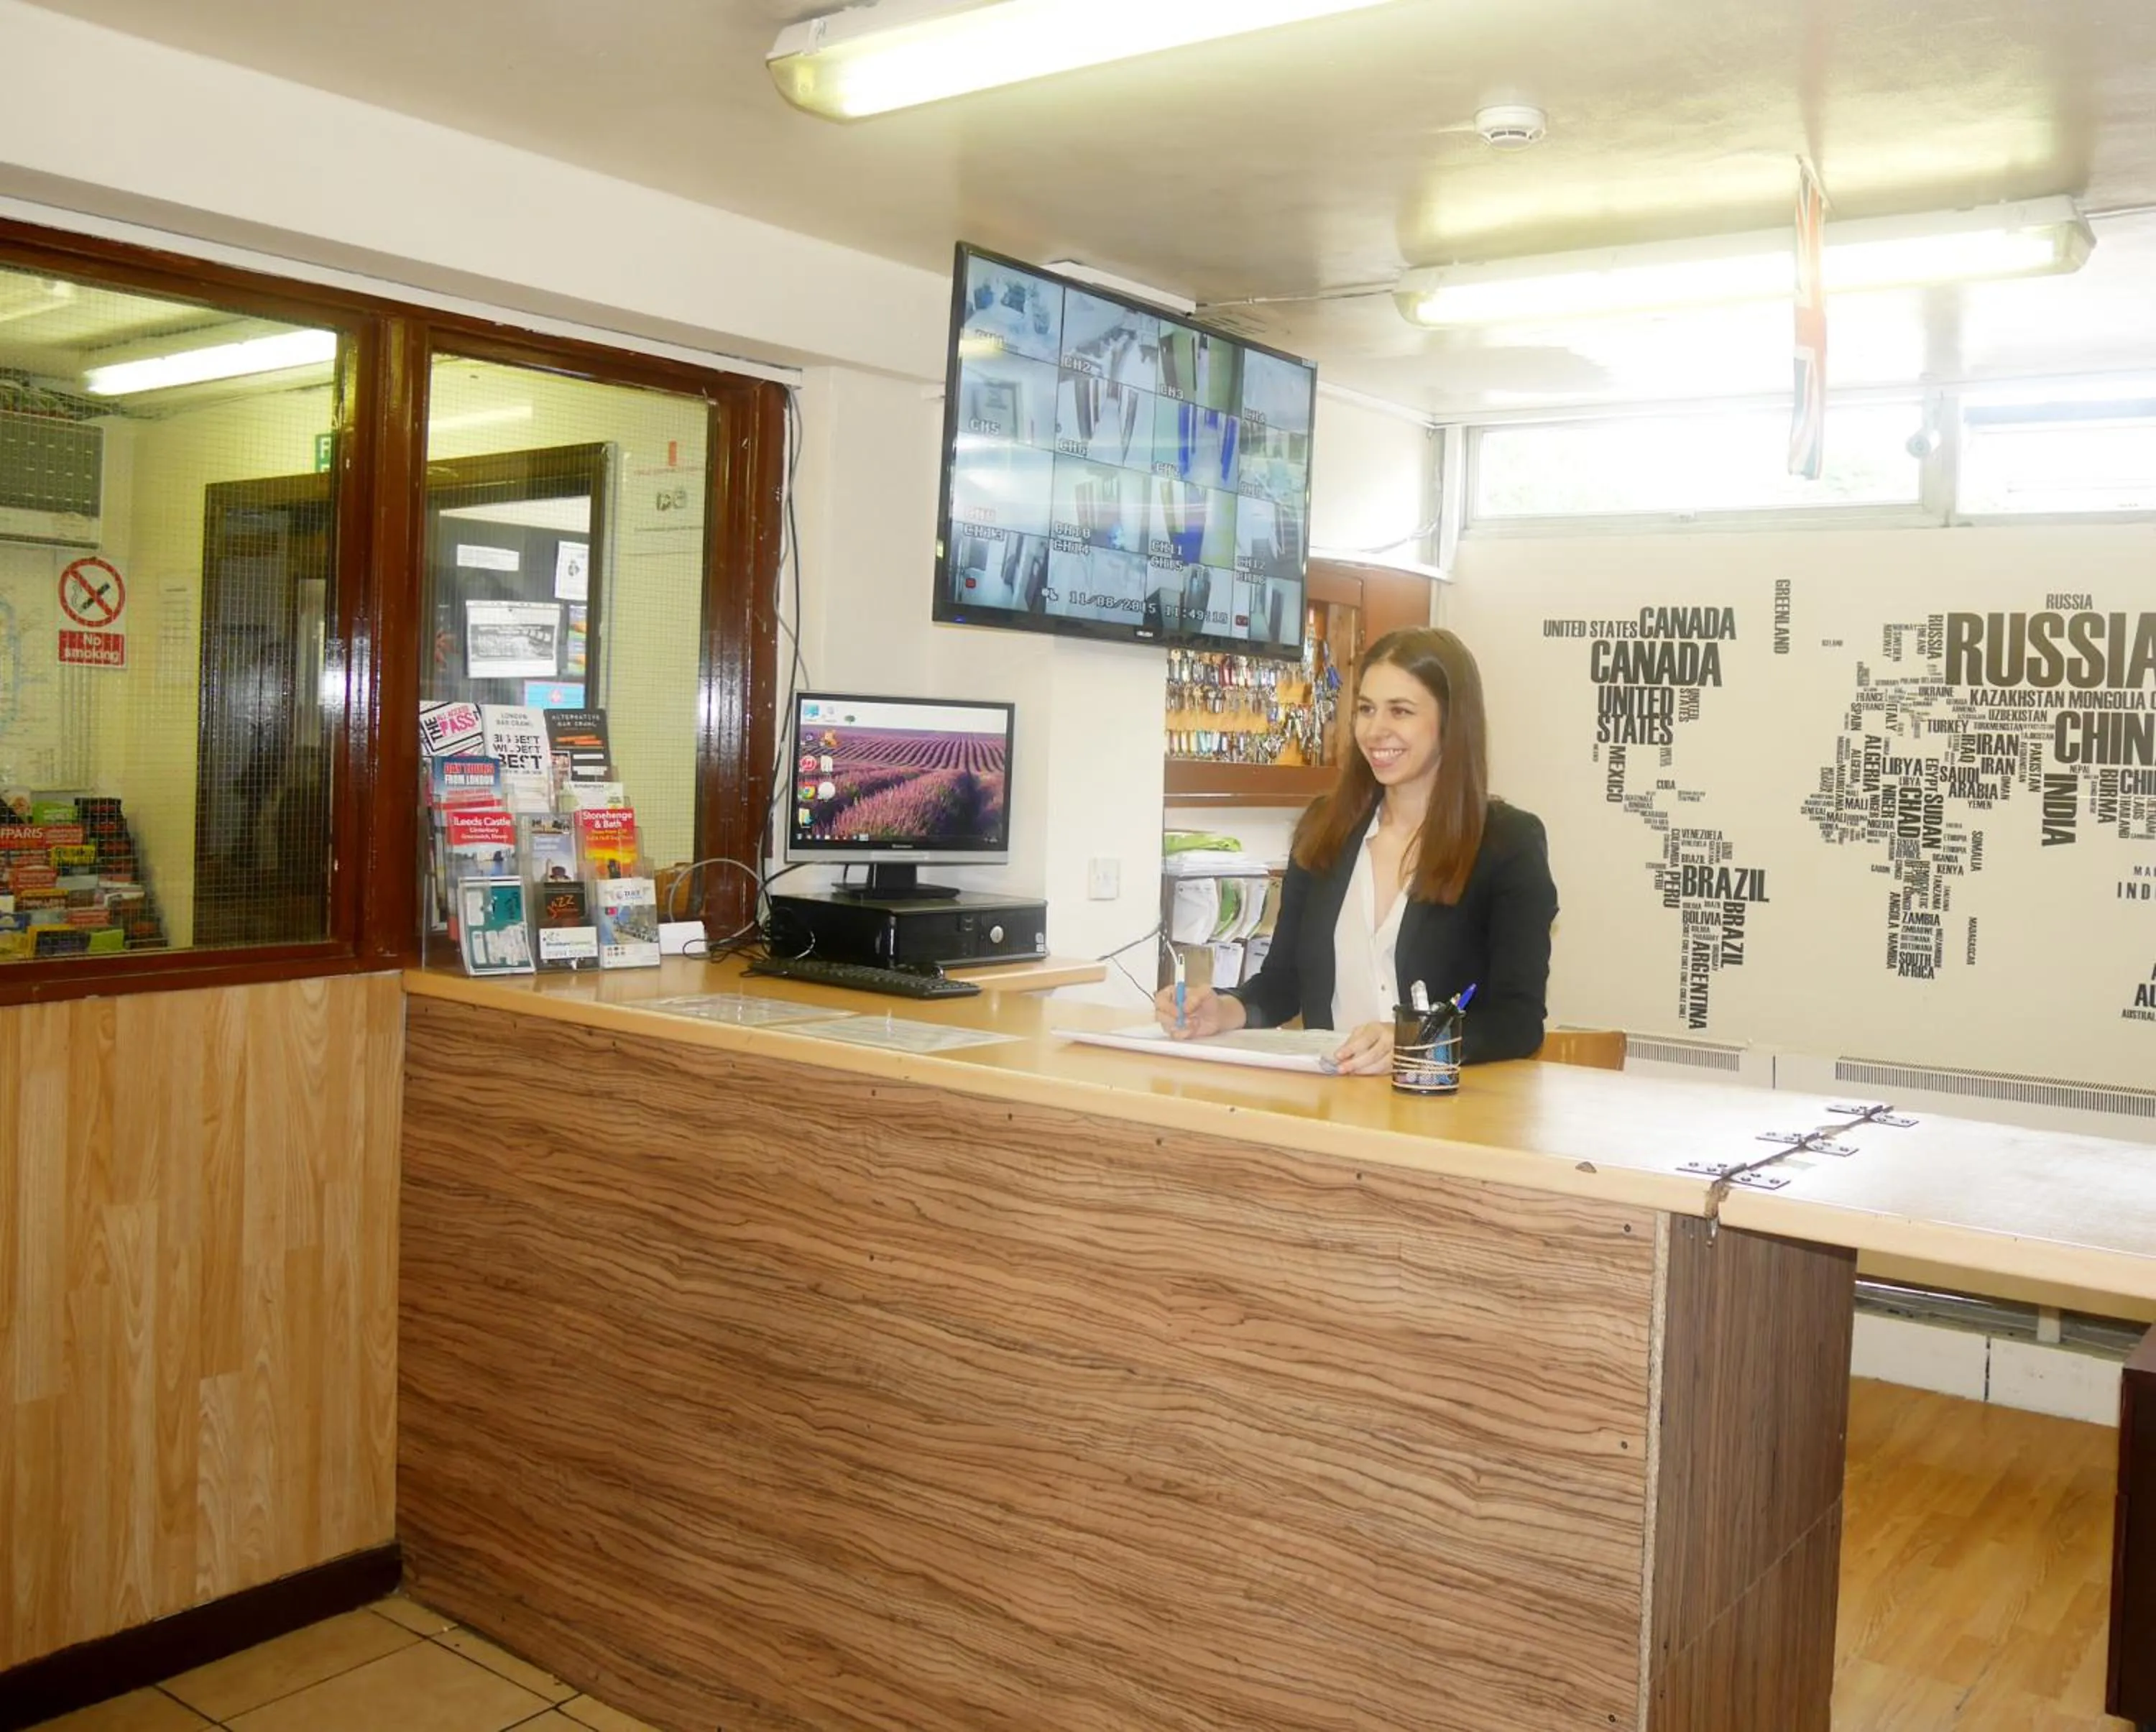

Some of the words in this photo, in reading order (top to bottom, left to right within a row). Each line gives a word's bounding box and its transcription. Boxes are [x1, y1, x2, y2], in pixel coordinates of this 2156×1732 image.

[1062, 355, 1092, 374] CH2
[1161, 384, 1184, 400] CH3
[969, 419, 1000, 435] CH5
[2046, 594, 2093, 610] RUSSIA
[1543, 619, 1585, 637] UNITED
[1590, 621, 1638, 639] STATES
[1639, 607, 1736, 640] CANADA
[1773, 579, 1790, 655] GREENLAND
[83, 633, 101, 646] No
[1927, 614, 1943, 660] RUSSIA
[1945, 612, 2156, 689] RUSSIA
[1590, 640, 1722, 687] CANADA
[1598, 685, 1674, 719] UNITED
[1856, 692, 1884, 702] FRANCE
[1918, 686, 1954, 697] UKRAINE
[1970, 689, 2065, 708] KAZAKHSTAN
[2068, 691, 2145, 710] MONGOLIA
[438, 712, 476, 737] PASS
[1851, 702, 1862, 731] SPAIN
[1885, 704, 1898, 732] ITALY
[1927, 719, 1969, 734] TURKEY
[1989, 709, 2047, 722] UZBEKISTAN
[423, 717, 444, 744] THE
[1597, 713, 1674, 745] STATES
[2054, 711, 2156, 766] CHIN
[1960, 734, 1976, 763] IRAQ
[1976, 733, 2019, 757] IRAN
[1606, 746, 1626, 803] MEXICO
[1850, 748, 1862, 783] ALGERIA
[1863, 734, 1882, 793] ALGERIA
[1882, 757, 1923, 776] LIBYA
[1925, 758, 1939, 793] EGYPT
[1940, 765, 1980, 783] SAUDI
[1981, 757, 2016, 775] IRAN
[2028, 742, 2042, 793] PAKISTAN
[1656, 779, 1676, 790] CUBA
[1948, 781, 1998, 800] ARABIA
[2000, 775, 2011, 800] OMAN
[2120, 768, 2156, 796] CHI
[1845, 798, 1868, 810] MALI
[1881, 784, 1897, 819] NIGER
[1968, 800, 1992, 810] YEMEN
[2097, 768, 2119, 824] BURMA
[2132, 796, 2145, 820] LAOS
[453, 816, 483, 826] Leeds
[582, 810, 633, 822] Stonehenge
[1827, 811, 1846, 822] MALI
[1897, 787, 1922, 838] CHAD
[1922, 794, 1944, 849] SUDAN
[2041, 773, 2078, 847] INDIA
[2119, 794, 2132, 839] THAILAND
[1682, 829, 1723, 840] VENEZUELA
[1971, 830, 1984, 872] SOMALIA
[1937, 864, 1964, 876] KENYA
[2134, 865, 2156, 877] MA
[1663, 871, 1681, 908] PERU
[1682, 865, 1770, 903] BRAZIL
[2117, 882, 2156, 900] IND
[1682, 910, 1721, 926] BOLIVIA
[1888, 892, 1901, 929] ANGOLA
[1902, 911, 1940, 926] ZAMBIA
[1720, 902, 1745, 968] BRAZIL
[1886, 933, 1899, 969] NAMIBIA
[1899, 952, 1932, 966] SOUTH
[1898, 963, 1935, 980] AFRICA
[1689, 940, 1710, 1029] ARGENTINA
